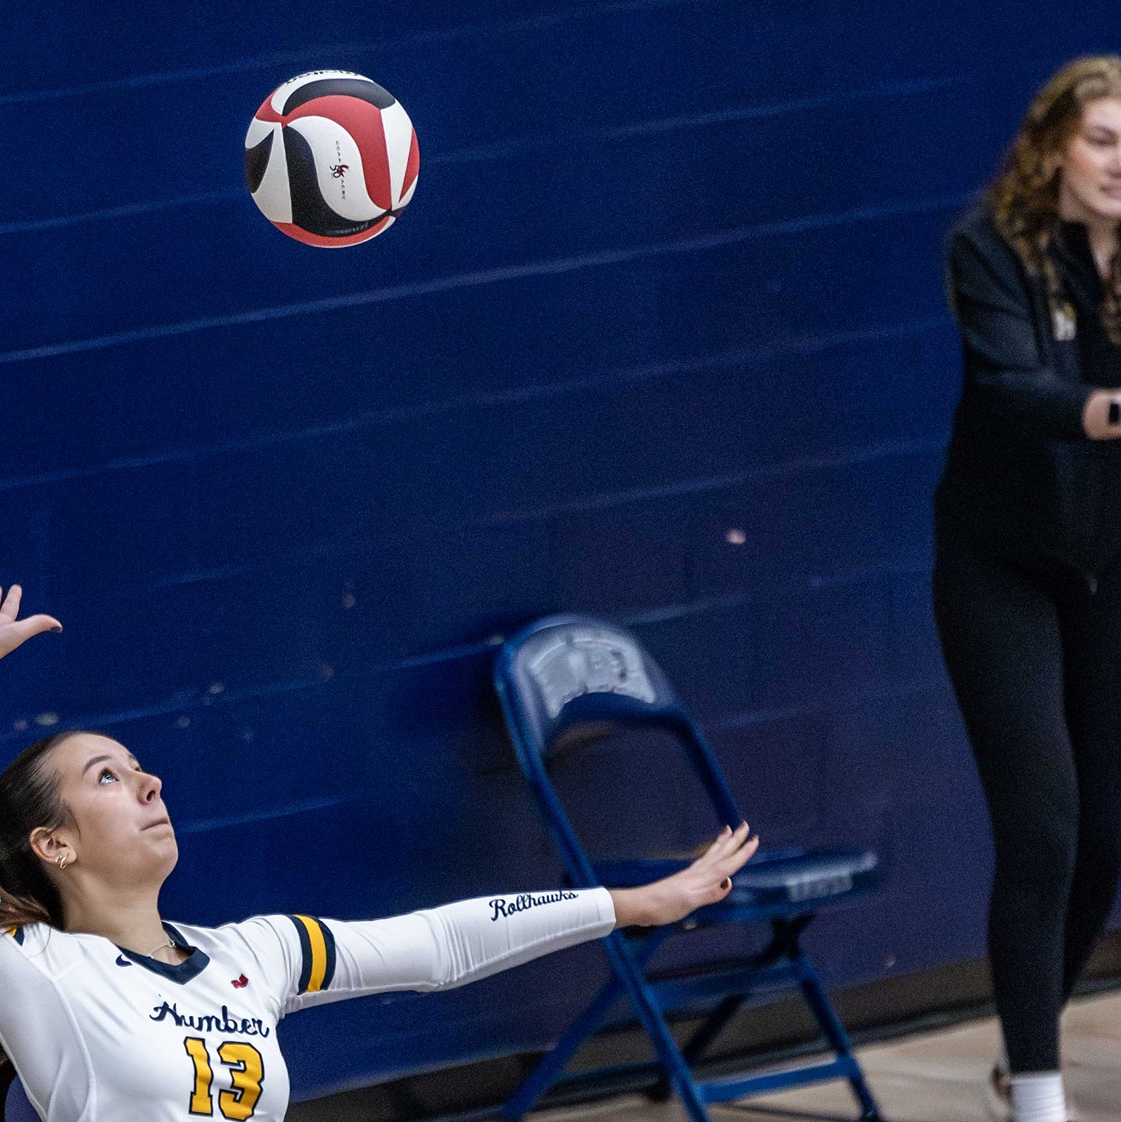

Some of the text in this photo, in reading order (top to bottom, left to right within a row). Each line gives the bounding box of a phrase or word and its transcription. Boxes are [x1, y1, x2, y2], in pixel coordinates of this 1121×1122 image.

[489, 890, 579, 921] Rollhawks
[149, 1000, 270, 1038] Humber
[183, 1036, 265, 1122] 13
